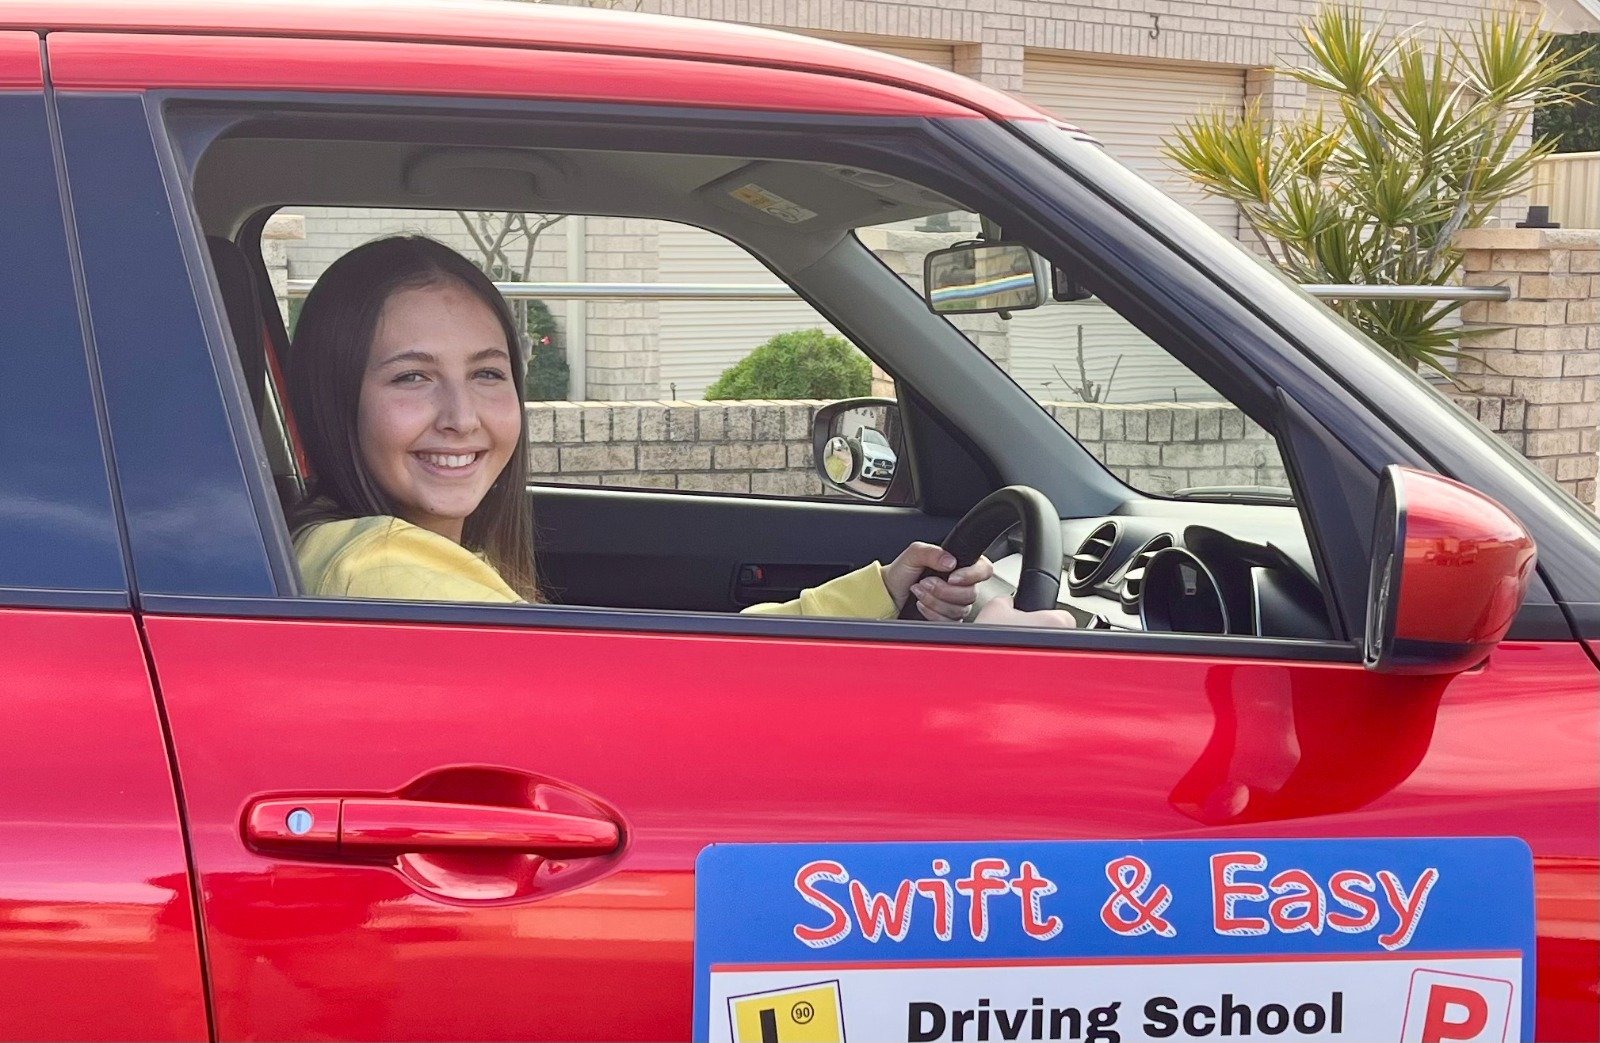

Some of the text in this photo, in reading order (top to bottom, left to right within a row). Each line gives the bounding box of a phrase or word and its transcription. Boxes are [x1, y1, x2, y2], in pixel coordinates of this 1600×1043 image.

[1149, 13, 1160, 39] 3
[793, 851, 1439, 951] Swift & Easy
[795, 1006, 810, 1019] 90
[907, 991, 1343, 1043] Driving School
[1421, 984, 1488, 1043] P
